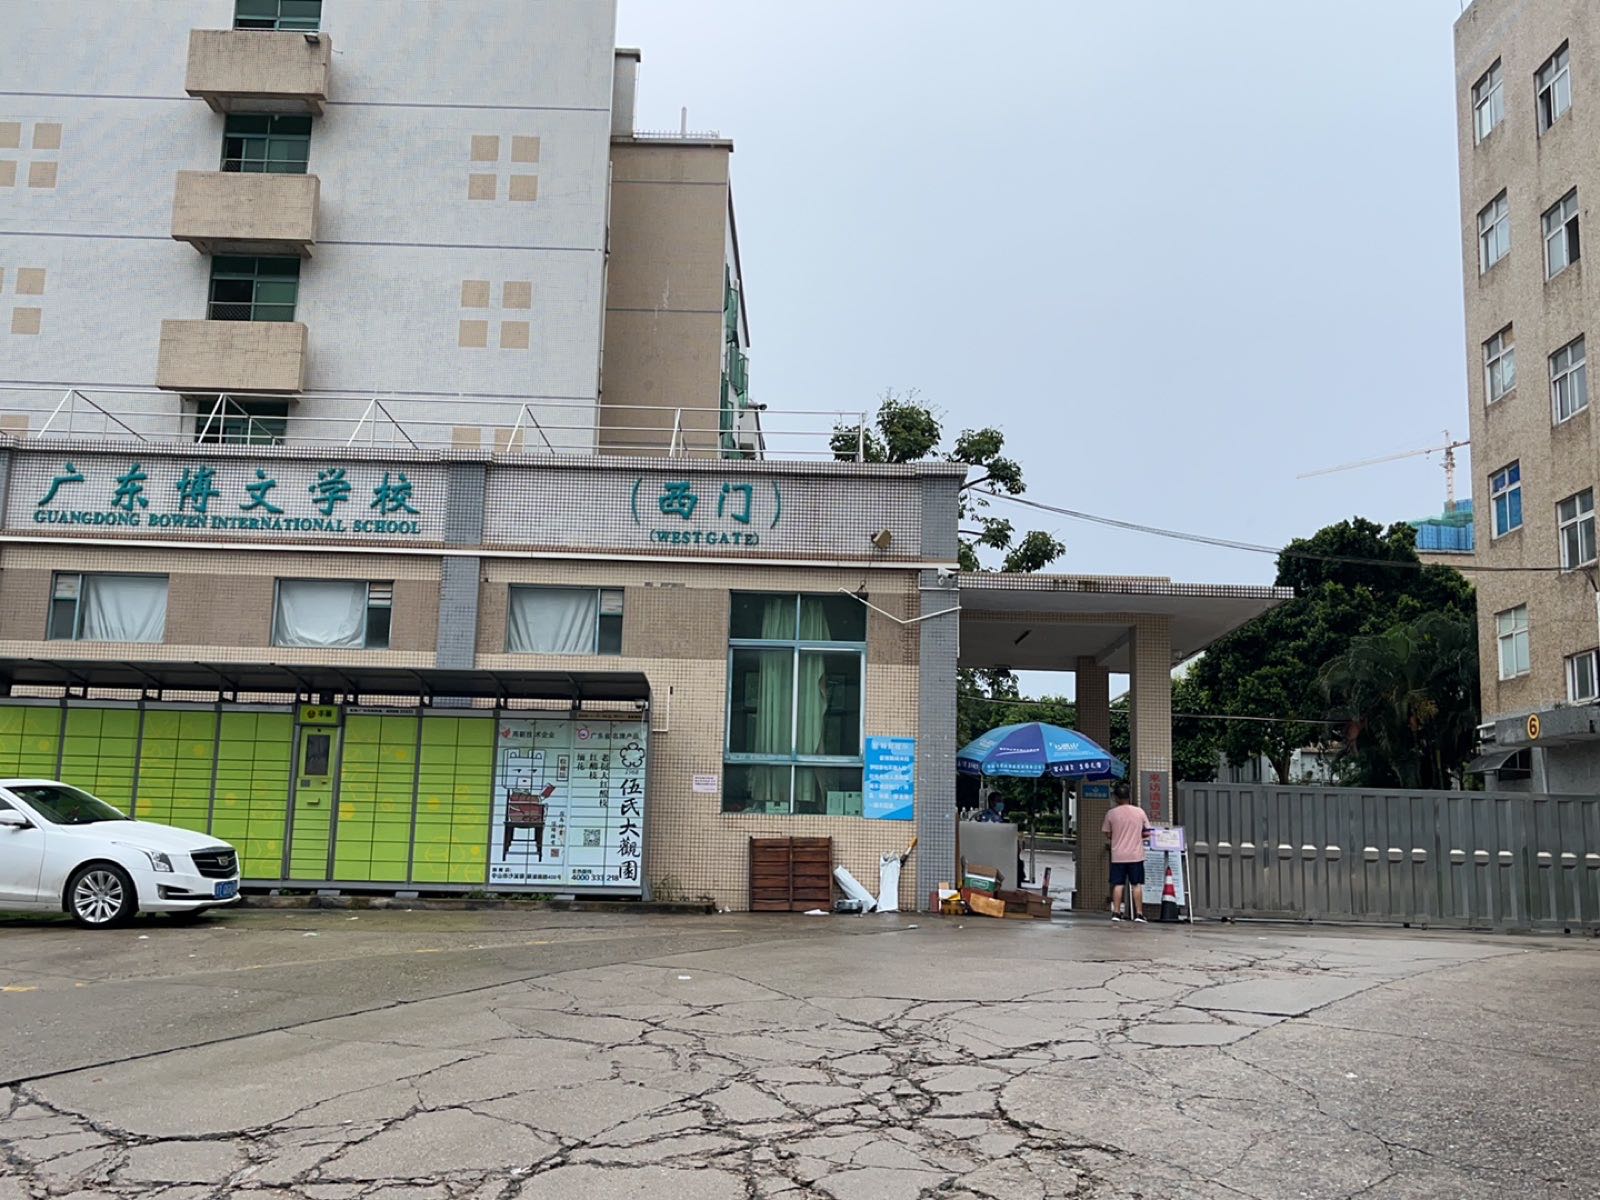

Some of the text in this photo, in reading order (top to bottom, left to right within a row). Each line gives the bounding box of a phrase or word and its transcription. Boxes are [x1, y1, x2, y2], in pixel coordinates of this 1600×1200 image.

[38, 462, 421, 516] 广东博文学校
[33, 508, 421, 535] GUANGDONG BOWEN INTERNATIONAL SCHOOL
[1529, 717, 1538, 735] 6
